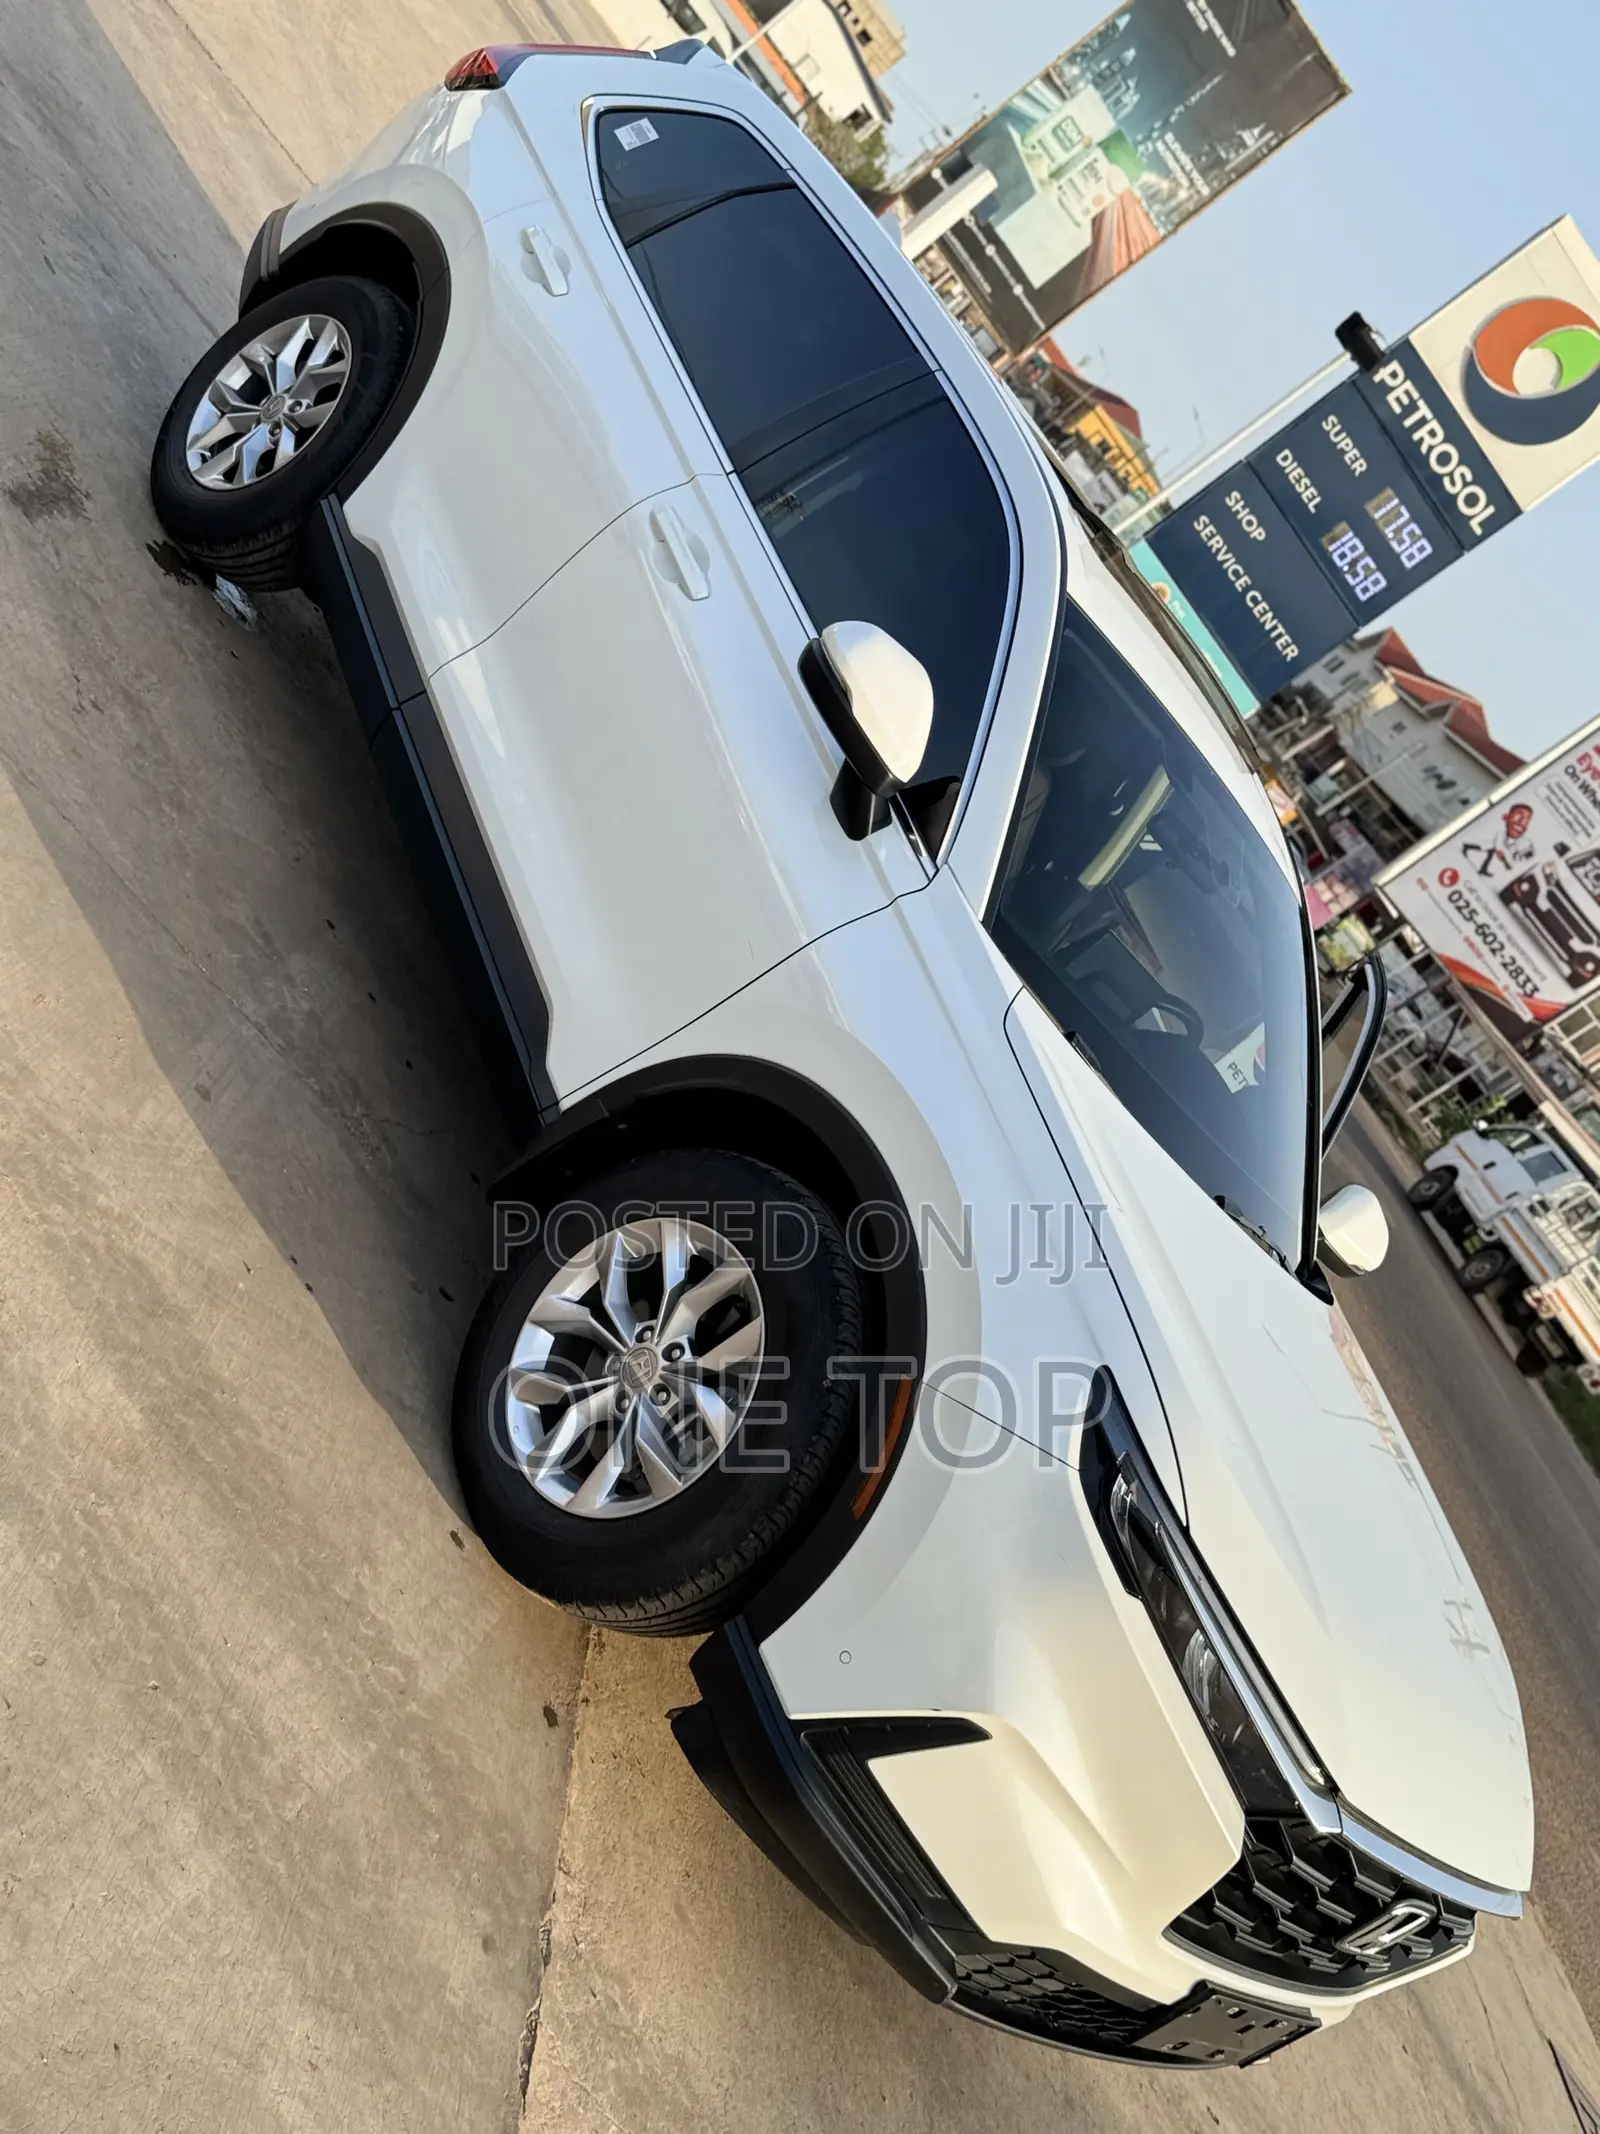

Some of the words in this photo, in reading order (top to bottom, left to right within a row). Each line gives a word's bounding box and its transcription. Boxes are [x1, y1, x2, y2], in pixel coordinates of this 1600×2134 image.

[1225, 490, 1267, 542] SHOP
[1321, 414, 1368, 477] SUPER
[1373, 497, 1433, 571] 17.58
[1373, 359, 1495, 536] PETROSOL
[1193, 514, 1253, 592] SERVICE
[1245, 590, 1299, 662] CENTER
[1275, 448, 1322, 514] DIESEL
[1327, 531, 1387, 602] 18.58
[1564, 764, 1580, 783] On
[1447, 890, 1540, 997] 025-602-2833
